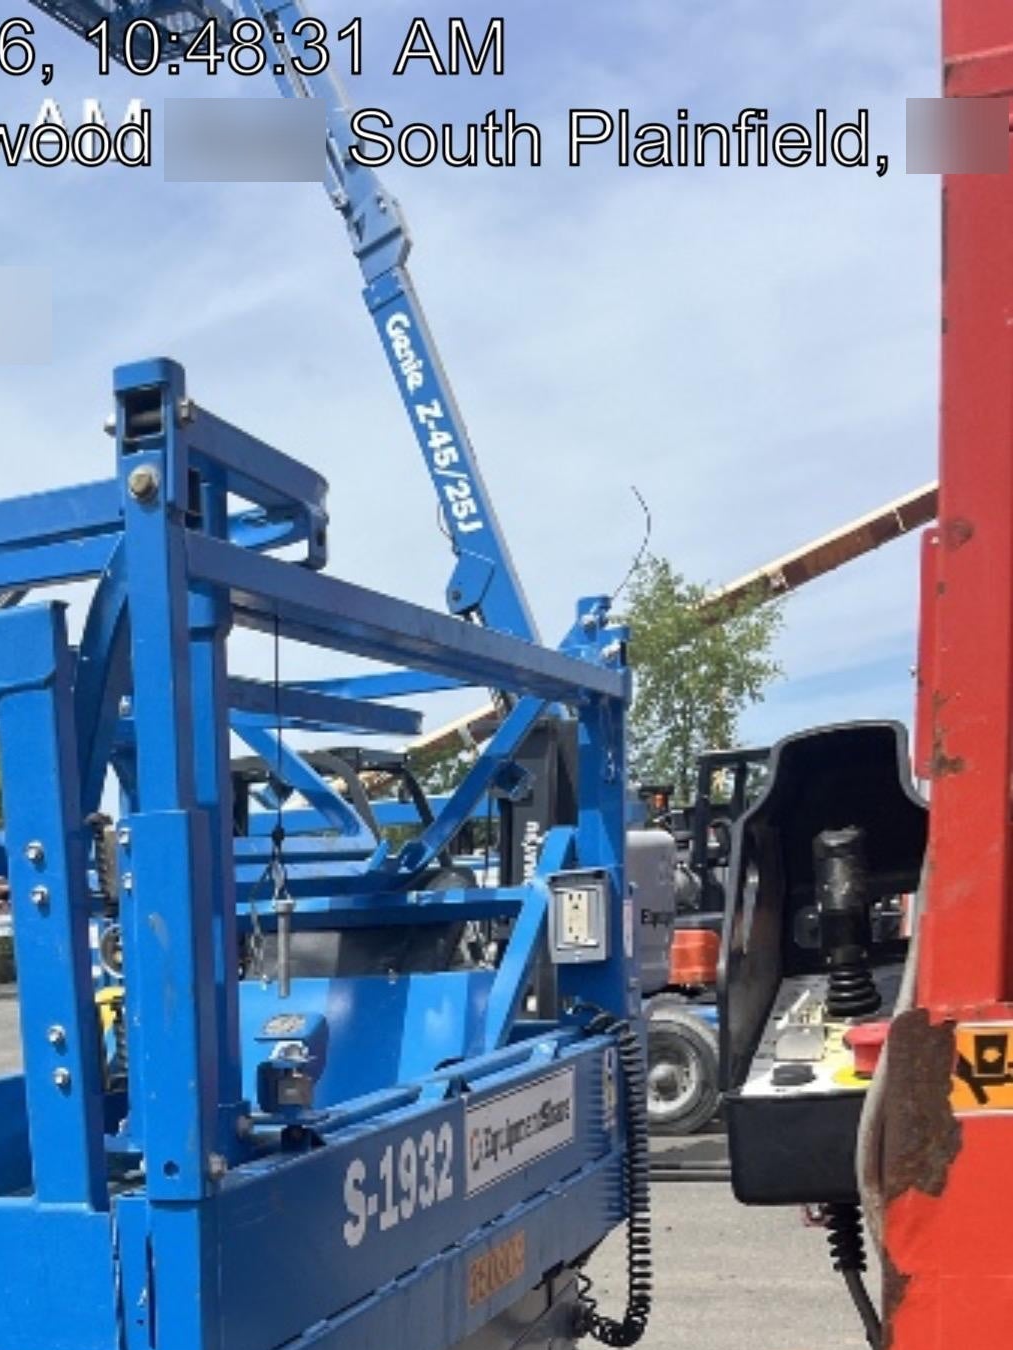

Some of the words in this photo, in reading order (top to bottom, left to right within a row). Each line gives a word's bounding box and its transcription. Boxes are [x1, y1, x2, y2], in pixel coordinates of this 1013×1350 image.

[385, 311, 424, 396] Genie
[414, 399, 484, 534] Z-45/25J
[343, 1121, 454, 1248] S-1932
